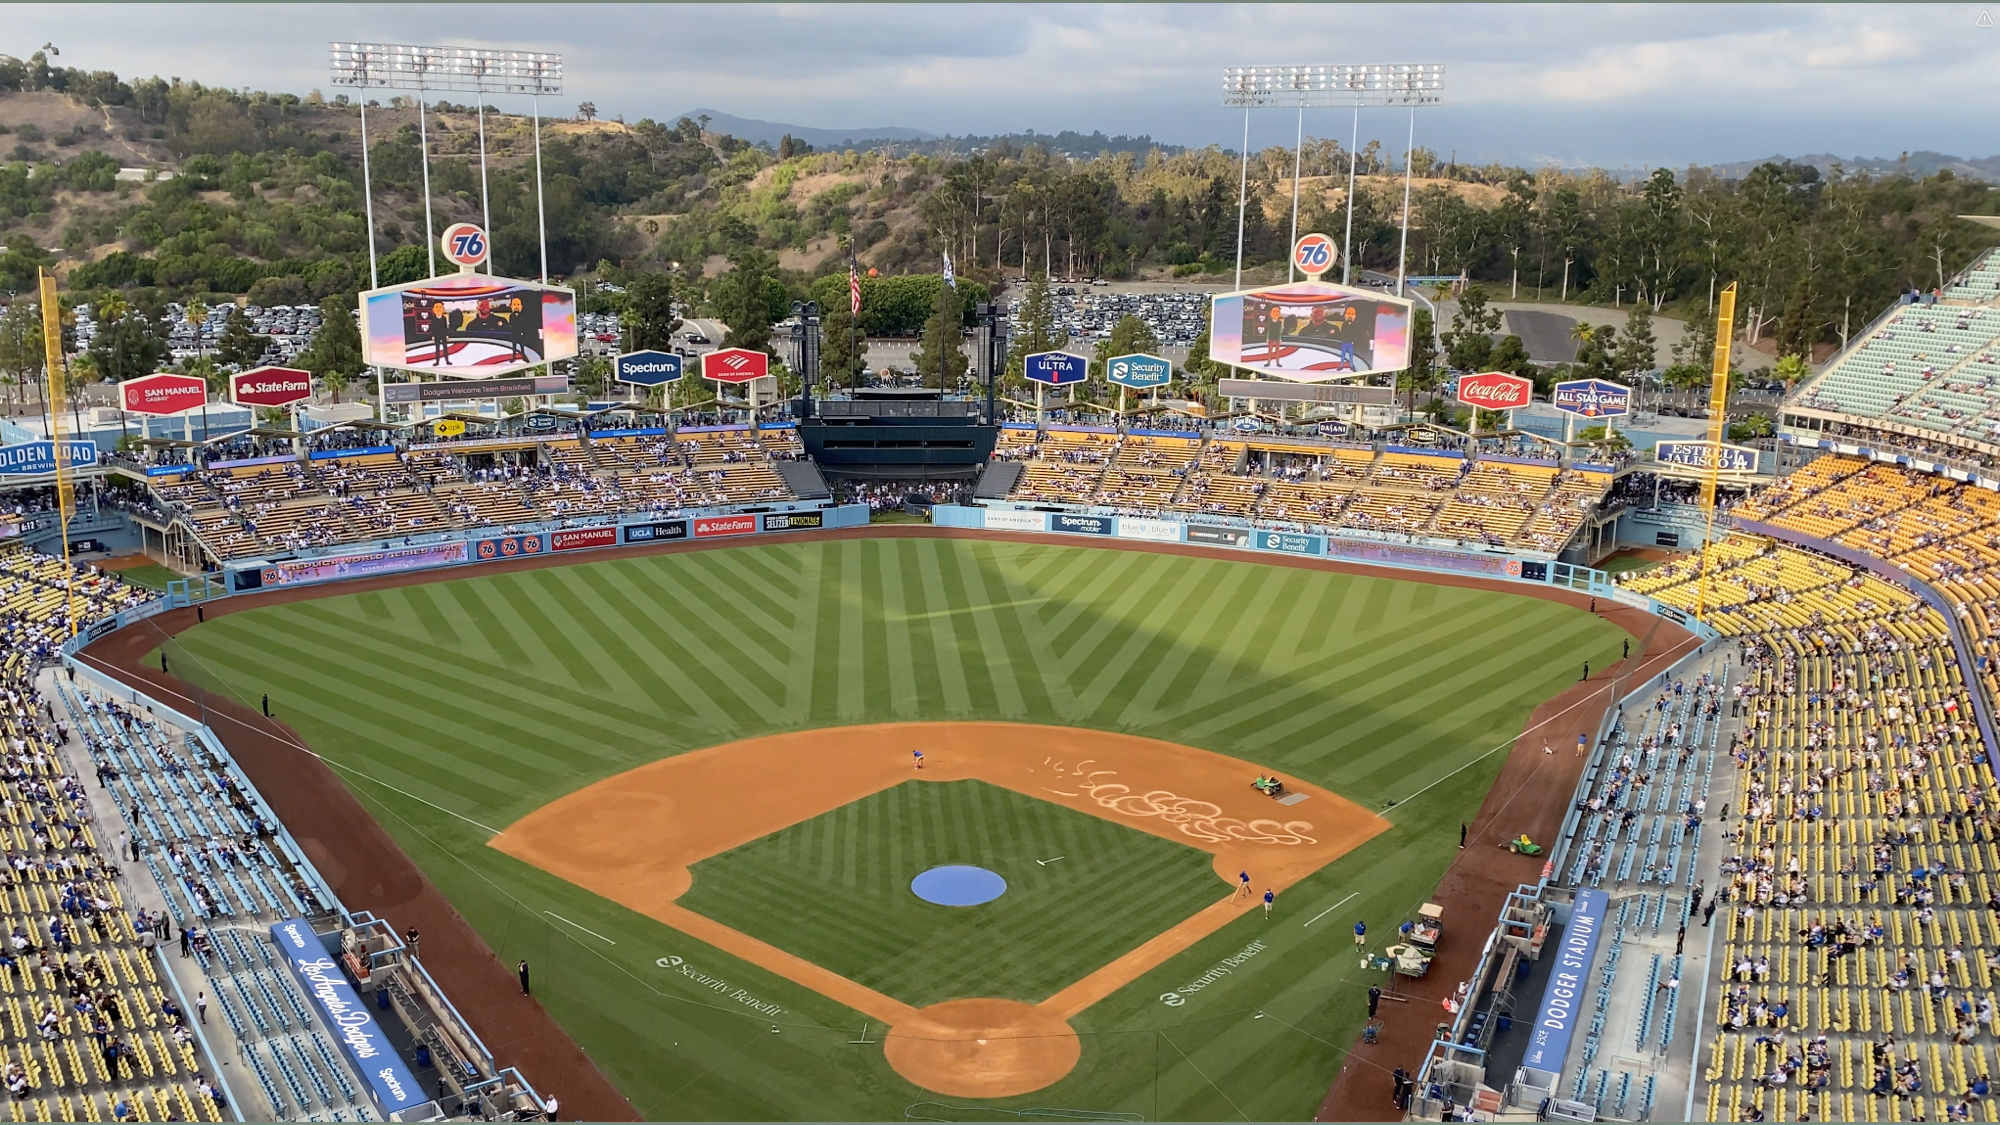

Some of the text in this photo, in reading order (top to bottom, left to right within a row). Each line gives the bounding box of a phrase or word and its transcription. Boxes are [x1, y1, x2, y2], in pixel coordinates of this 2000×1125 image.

[452, 232, 485, 258] 76
[1298, 241, 1329, 267] 76
[622, 361, 674, 375] Spectrum
[1038, 361, 1073, 371] ULTRA
[1131, 362, 1165, 374] Security
[1131, 371, 1160, 382] Benefit
[145, 386, 202, 397] SAN MANUEL
[423, 388, 450, 397] Dodgers
[451, 387, 481, 395] Welcome
[500, 384, 531, 392] Brookfield
[1464, 381, 1522, 402] Coca-Cola
[1558, 392, 1574, 402] ALL
[1599, 395, 1627, 406] GAME
[1320, 424, 1346, 433] DASANI
[1845, 415, 1906, 433] DODGER
[1916, 429, 1979, 449] STADIUM
[1664, 453, 1729, 469] JALISCO
[766, 519, 788, 529] SELTZER
[1061, 516, 1101, 527] Spectrum
[1121, 522, 1139, 531] blue
[655, 526, 682, 536] Health
[1151, 525, 1168, 533] blue
[562, 530, 613, 541] SAN MANUEL
[1282, 535, 1310, 546] Security
[482, 544, 493, 554] 76
[504, 541, 515, 551] 76
[526, 539, 537, 549] 76
[1282, 542, 1306, 551] Benefit
[1388, 545, 1424, 554] WORLD
[343, 553, 384, 564] WORLD
[387, 547, 428, 559] SERIES
[264, 572, 275, 581] 76
[284, 923, 306, 949] Spectrum
[1177, 940, 1267, 996] Security Benefit
[1544, 915, 1595, 1030] DODGER STADIUM
[675, 963, 783, 1017] Security Benefit
[298, 957, 380, 1058] Los Angeles Dodgers
[378, 1067, 407, 1101] Spectrum
